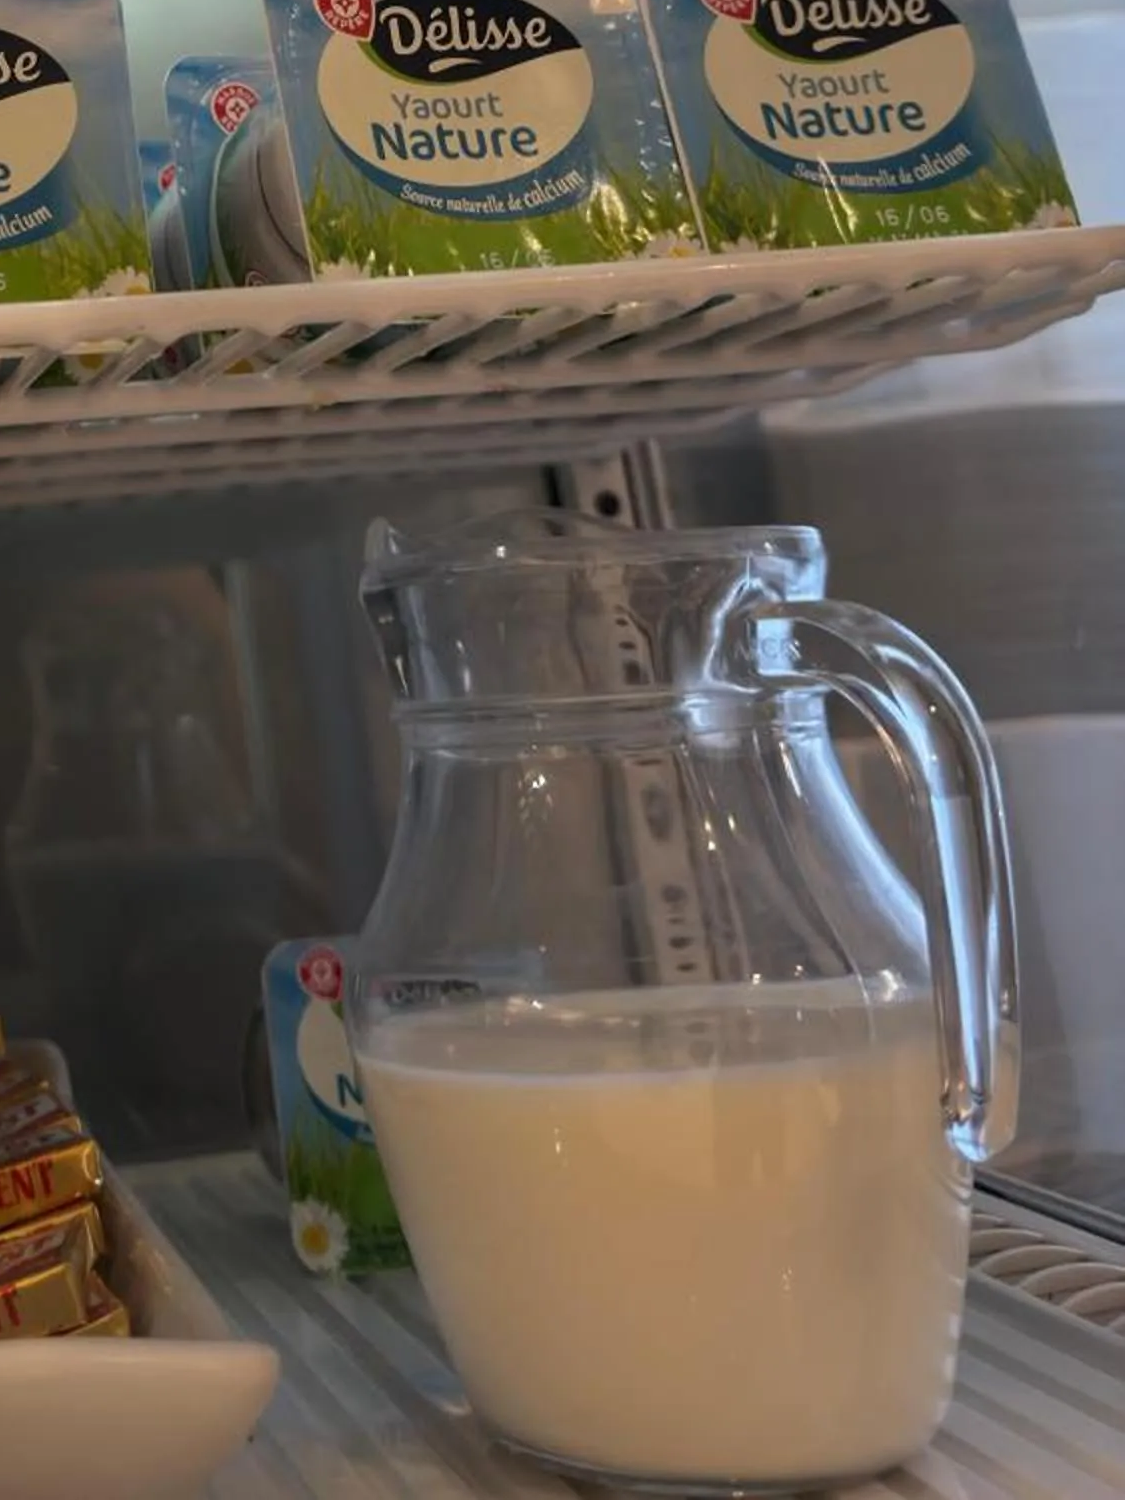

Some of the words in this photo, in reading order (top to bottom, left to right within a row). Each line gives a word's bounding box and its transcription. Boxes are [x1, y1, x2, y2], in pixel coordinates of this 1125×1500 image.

[379, 5, 551, 56] Délisse
[779, 68, 890, 98] Yaourt
[391, 92, 504, 121] Yaourt
[761, 98, 927, 140] Nature
[371, 121, 539, 161] Nature
[840, 168, 900, 188] naturelle
[901, 165, 915, 186] de
[914, 143, 972, 182] calcium
[446, 193, 506, 214] naturelle
[508, 192, 524, 212] de
[524, 168, 586, 209] calcium
